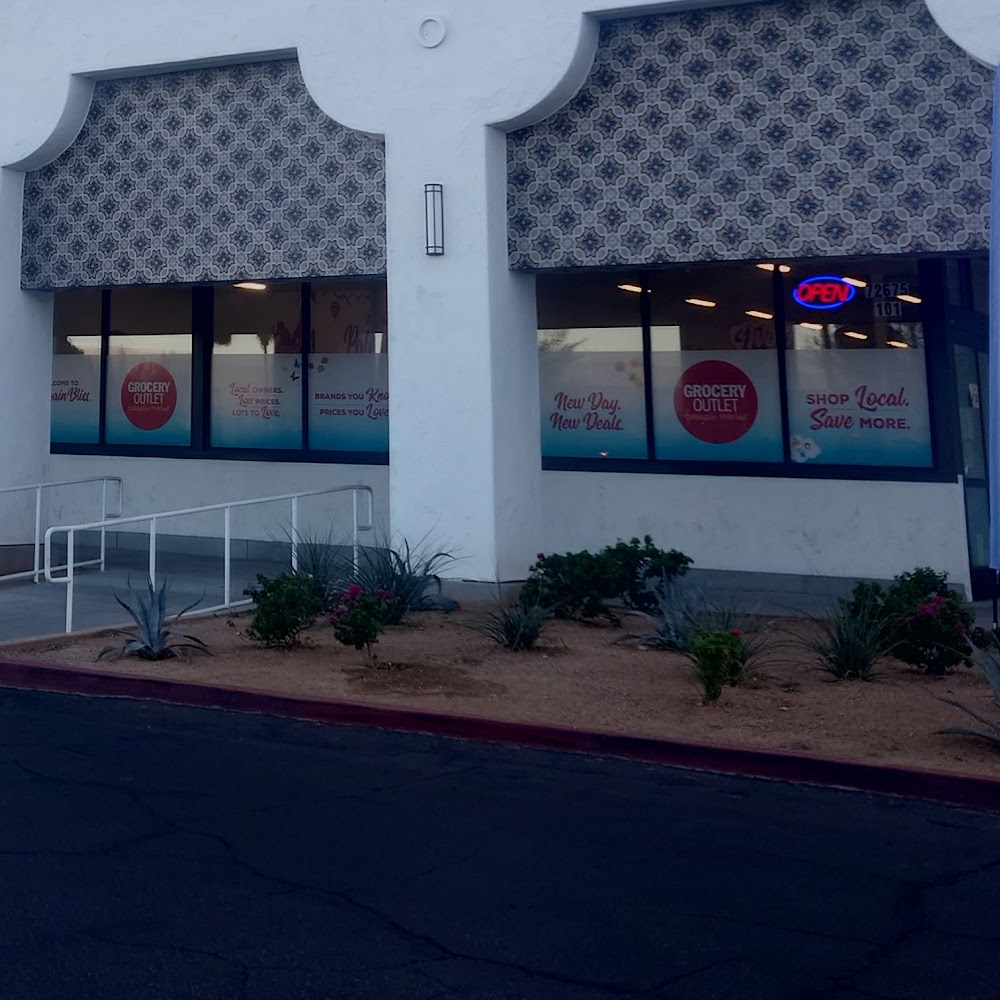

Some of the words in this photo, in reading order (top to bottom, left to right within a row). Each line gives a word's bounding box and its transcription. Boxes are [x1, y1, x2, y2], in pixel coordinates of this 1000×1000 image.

[797, 281, 852, 303] OPEN
[865, 282, 909, 298] 72675
[877, 302, 901, 316] 101
[127, 381, 171, 393] GROCERY
[230, 382, 250, 396] Local
[683, 384, 747, 399] GROCERY
[133, 392, 165, 405] OUTLET
[238, 394, 254, 408] Low
[365, 387, 389, 403] Kno
[806, 393, 850, 405] SHOP
[855, 384, 909, 412] Local.
[554, 392, 586, 411] New
[587, 391, 622, 415] Day.
[692, 398, 739, 412] OUTLET
[232, 409, 249, 417] LOTS
[250, 409, 260, 417] TO
[319, 408, 347, 416] PRICES
[810, 407, 855, 430] Save
[860, 417, 911, 430] MORE.
[549, 411, 580, 431] New
[582, 411, 624, 431] Deals.
